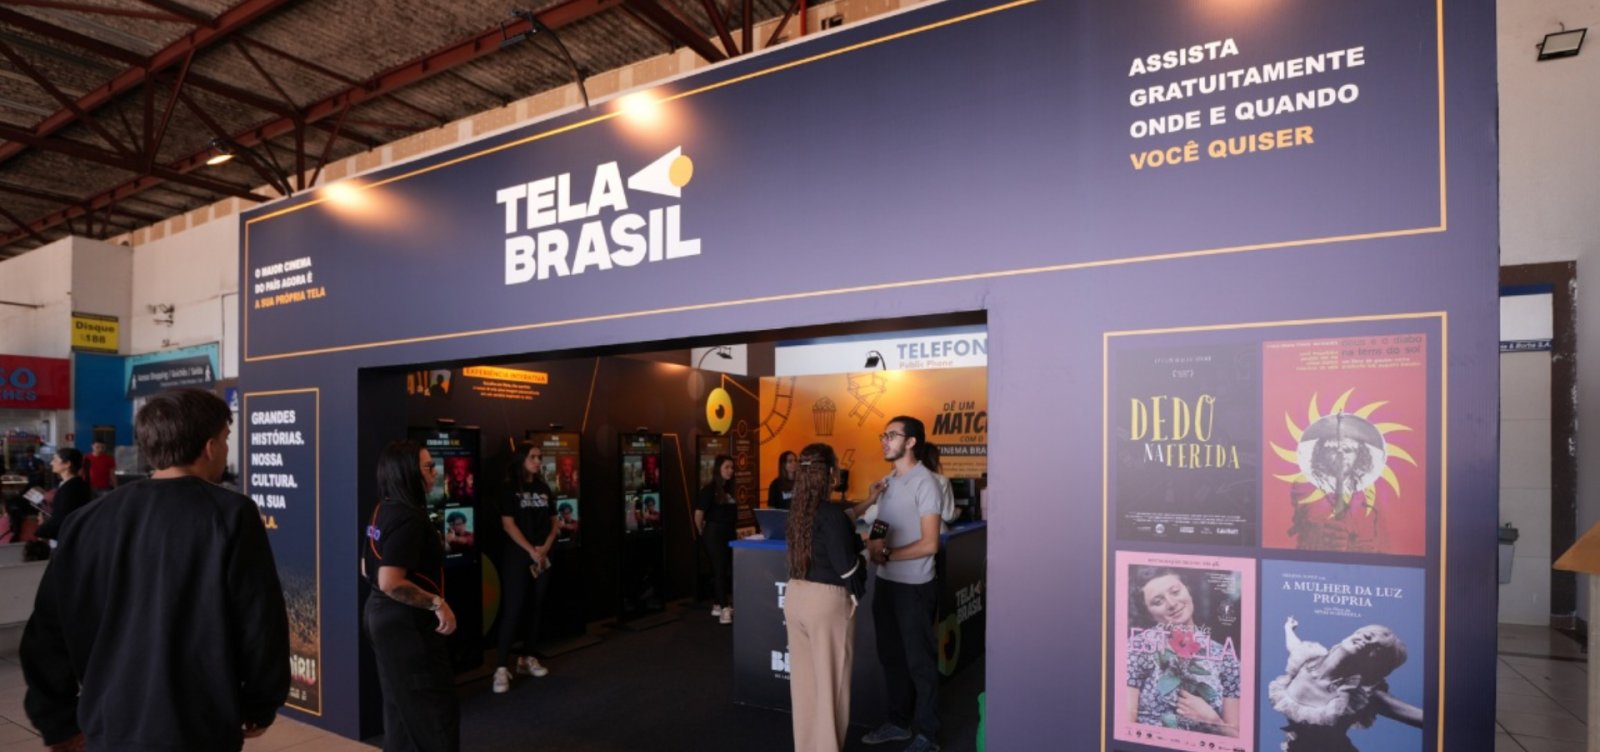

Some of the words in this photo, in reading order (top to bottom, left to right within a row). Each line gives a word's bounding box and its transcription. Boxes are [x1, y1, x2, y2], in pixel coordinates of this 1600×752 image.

[1128, 38, 1239, 77] ASSISTA
[1129, 46, 1365, 107] GRATUITAMENTE
[1130, 110, 1201, 138] ONDE
[1210, 106, 1226, 125] E
[1234, 84, 1359, 120] QUANDO
[1130, 140, 1199, 170] VOCÊ
[1208, 125, 1314, 158] QUISER
[496, 160, 629, 234] TELA
[505, 204, 701, 285] BRASIL
[261, 263, 284, 277] MAIOR
[284, 256, 312, 272] CINEMA
[281, 274, 306, 288] AGORA
[306, 286, 326, 299] TELA
[76, 320, 115, 333] Disque
[959, 401, 975, 411] UM
[251, 410, 296, 425] GRANDES
[1129, 394, 1216, 442] DEDO
[251, 430, 304, 446] HISTÓRIAS.
[251, 453, 283, 467] NOSSA
[1165, 443, 1240, 470] FERIDA
[251, 474, 298, 488] CULTURA.
[266, 495, 286, 509] SUA
[1282, 581, 1291, 590] A
[1294, 581, 1351, 595] MULHER
[1354, 585, 1373, 596] DA
[1376, 588, 1402, 598] LUZ
[1313, 591, 1373, 607] PRÓPRIA
[1128, 627, 1239, 664] ESTELA
